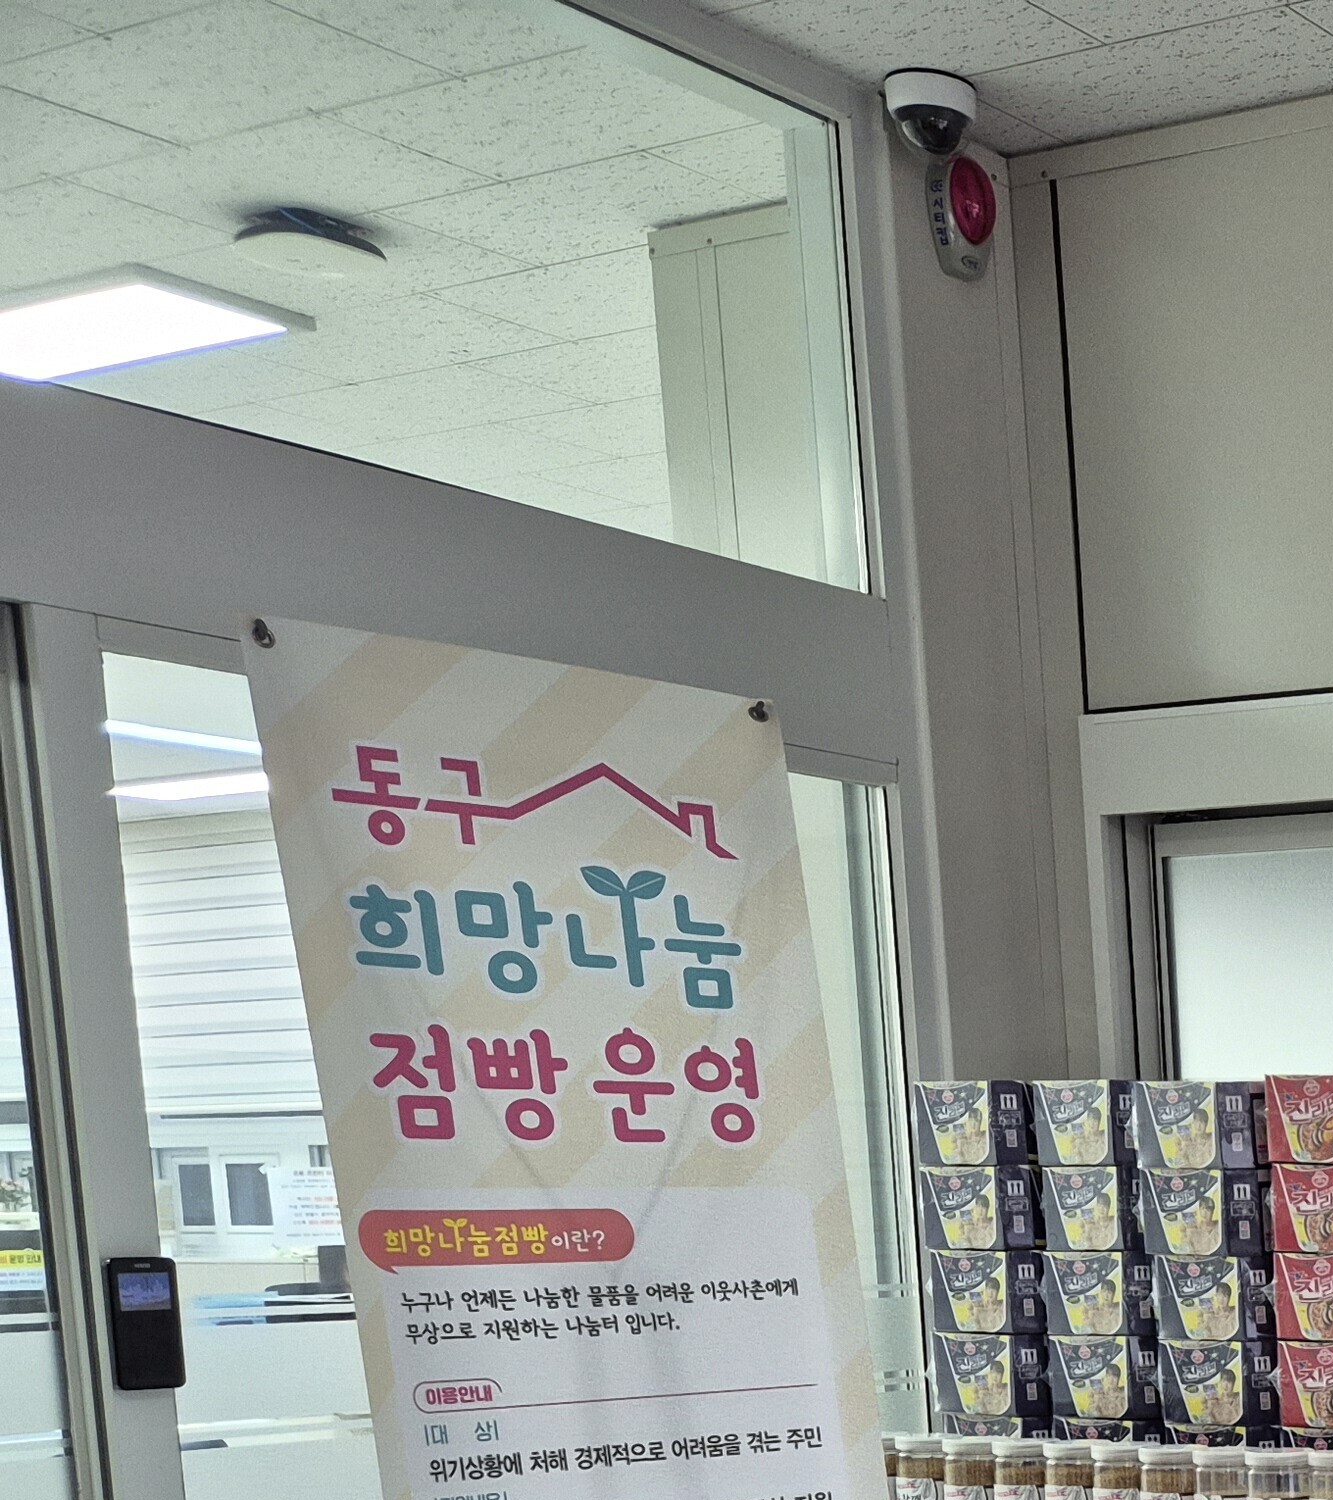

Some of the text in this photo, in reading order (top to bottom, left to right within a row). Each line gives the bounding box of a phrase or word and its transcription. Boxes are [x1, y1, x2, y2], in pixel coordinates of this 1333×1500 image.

[331, 744, 483, 846] 동구
[349, 867, 742, 1010] 희망나눔
[368, 1023, 760, 1143] 점빵 운영
[384, 1219, 607, 1258] 희망나눔점빵이란?
[401, 1277, 798, 1314] 누구나 언제든 나눔한 물품을 어려운 이웃사촌에게
[405, 1309, 680, 1345] 무상으로 지원하는 나눔터 입니다.
[425, 1383, 494, 1406] 이용안내
[429, 1425, 822, 1484] 위기상황에 처해 경제적으로 어려움을 겪는 주민
